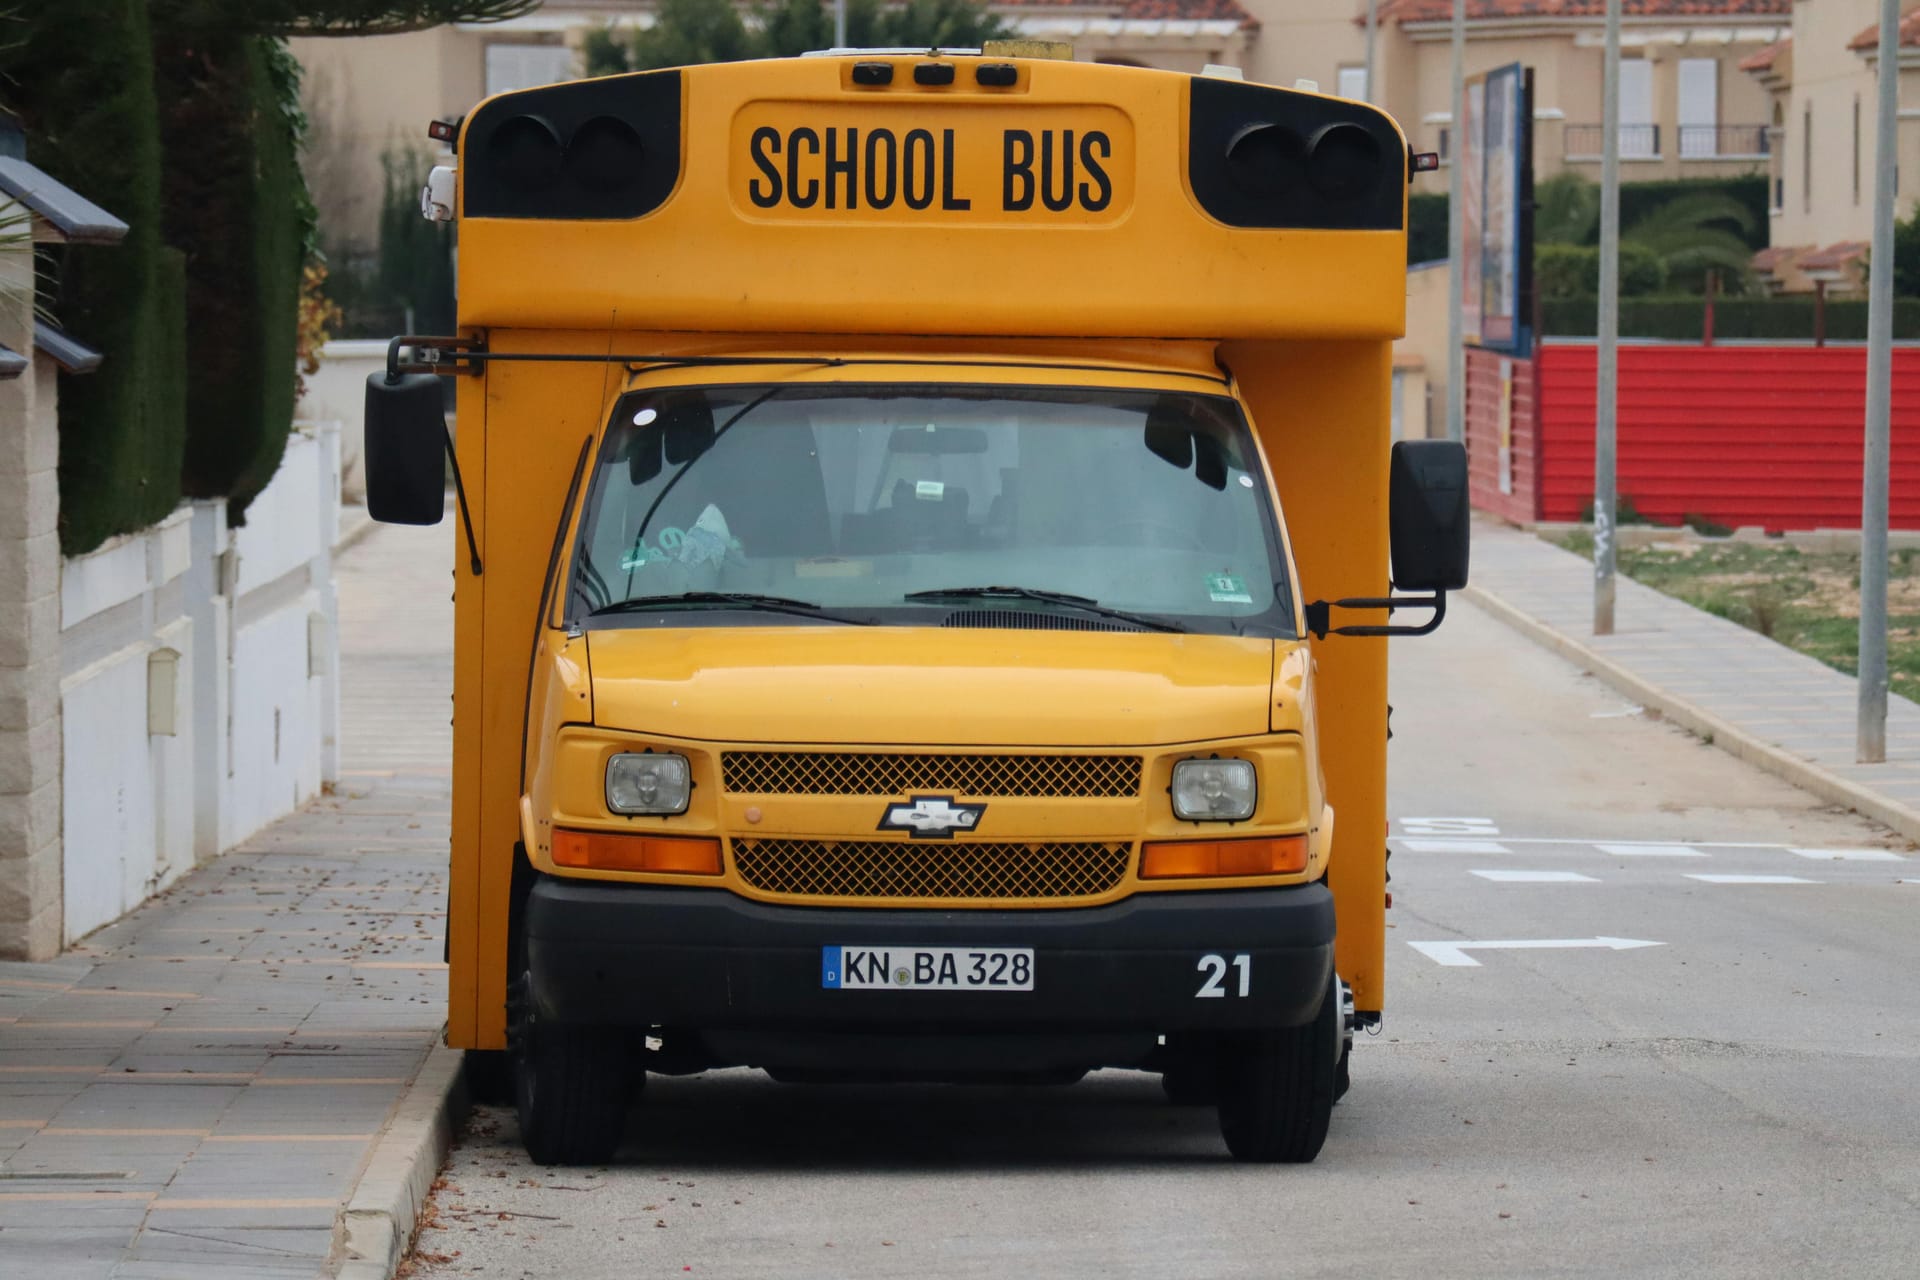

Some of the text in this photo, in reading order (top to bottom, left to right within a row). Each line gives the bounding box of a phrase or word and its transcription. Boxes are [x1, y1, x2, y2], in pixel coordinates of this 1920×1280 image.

[749, 126, 1112, 212] SCHOOL BUS
[827, 971, 836, 982] D
[845, 951, 1031, 985] KN BA 328
[1195, 954, 1251, 998] 21
